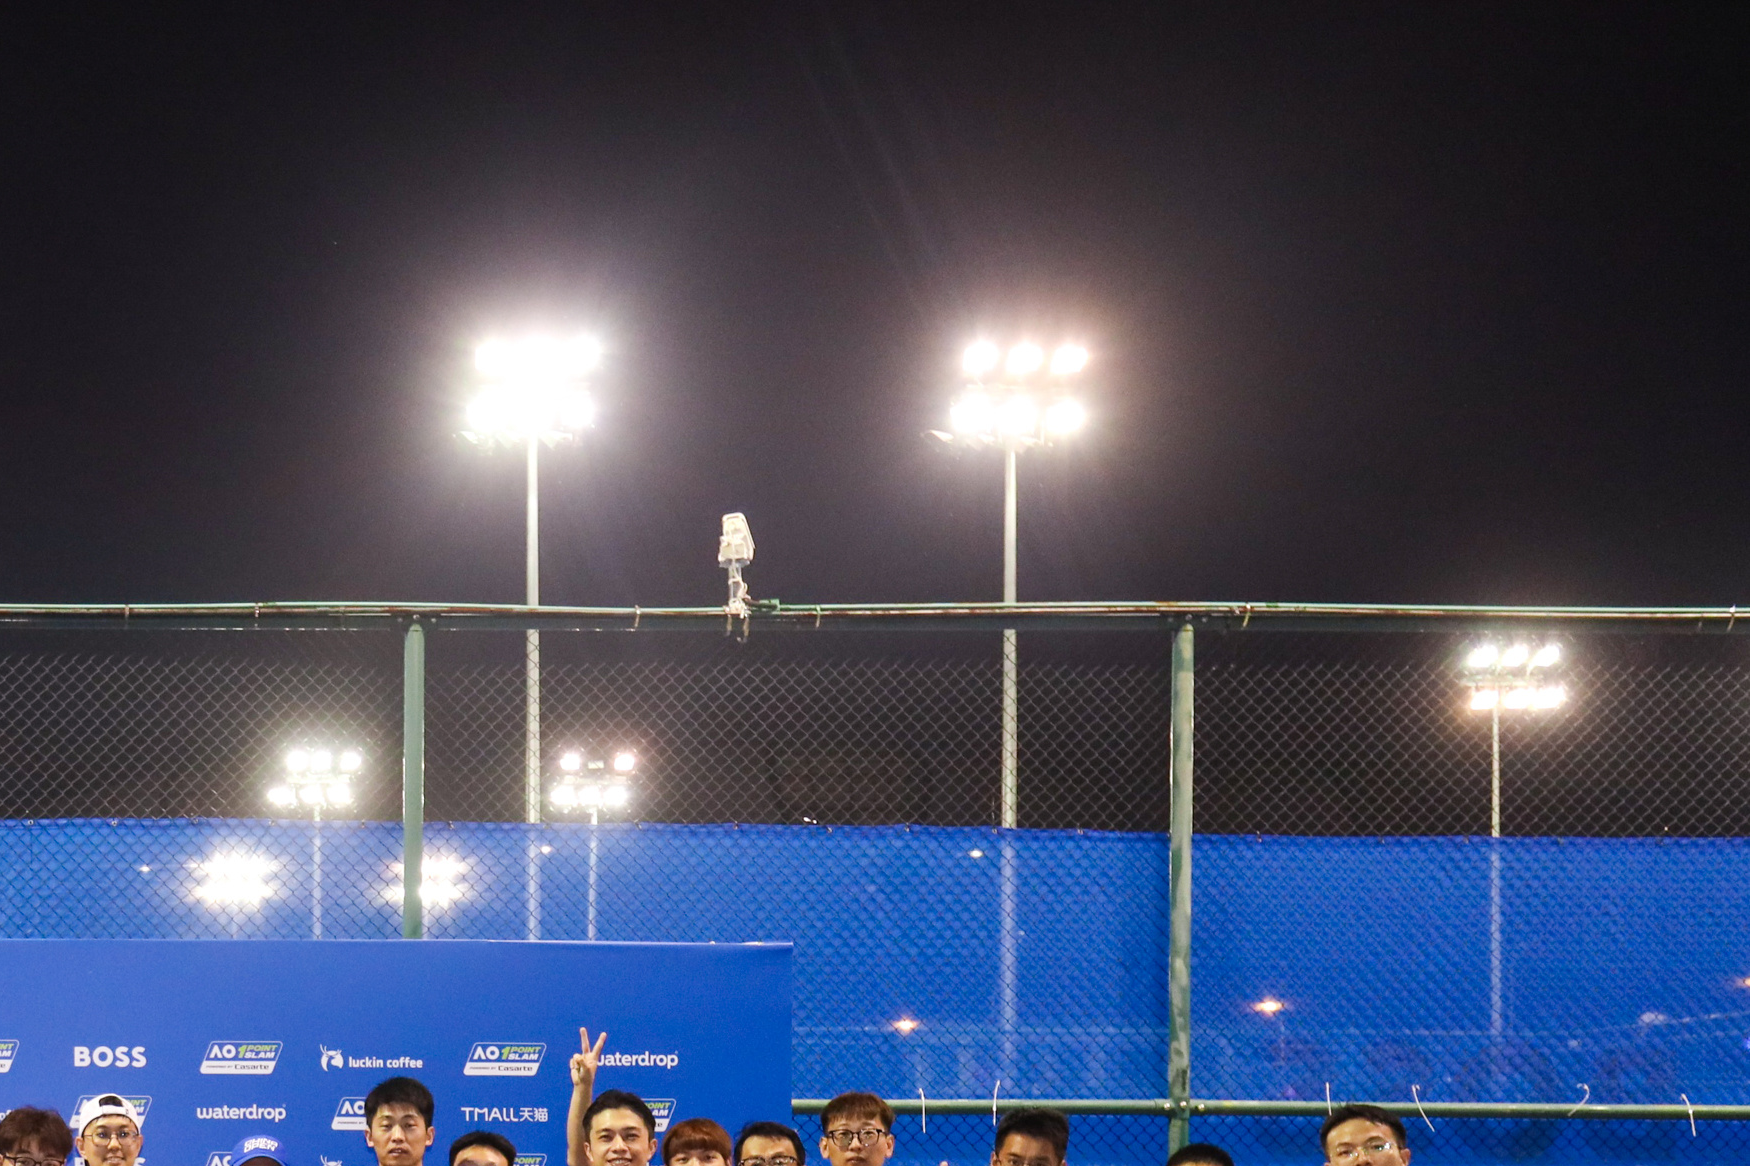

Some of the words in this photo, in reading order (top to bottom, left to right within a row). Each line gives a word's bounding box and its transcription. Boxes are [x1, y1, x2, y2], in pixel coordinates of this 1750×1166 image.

[74, 1046, 147, 1068] BOSS
[210, 1044, 236, 1058] AO
[238, 1045, 247, 1058] 1
[473, 1046, 500, 1060] AO
[501, 1046, 510, 1060] 1
[349, 1056, 383, 1068] luckin
[386, 1057, 423, 1068] coffee
[196, 1104, 287, 1123] waterdrop
[461, 1107, 548, 1122] TMALL天猫
